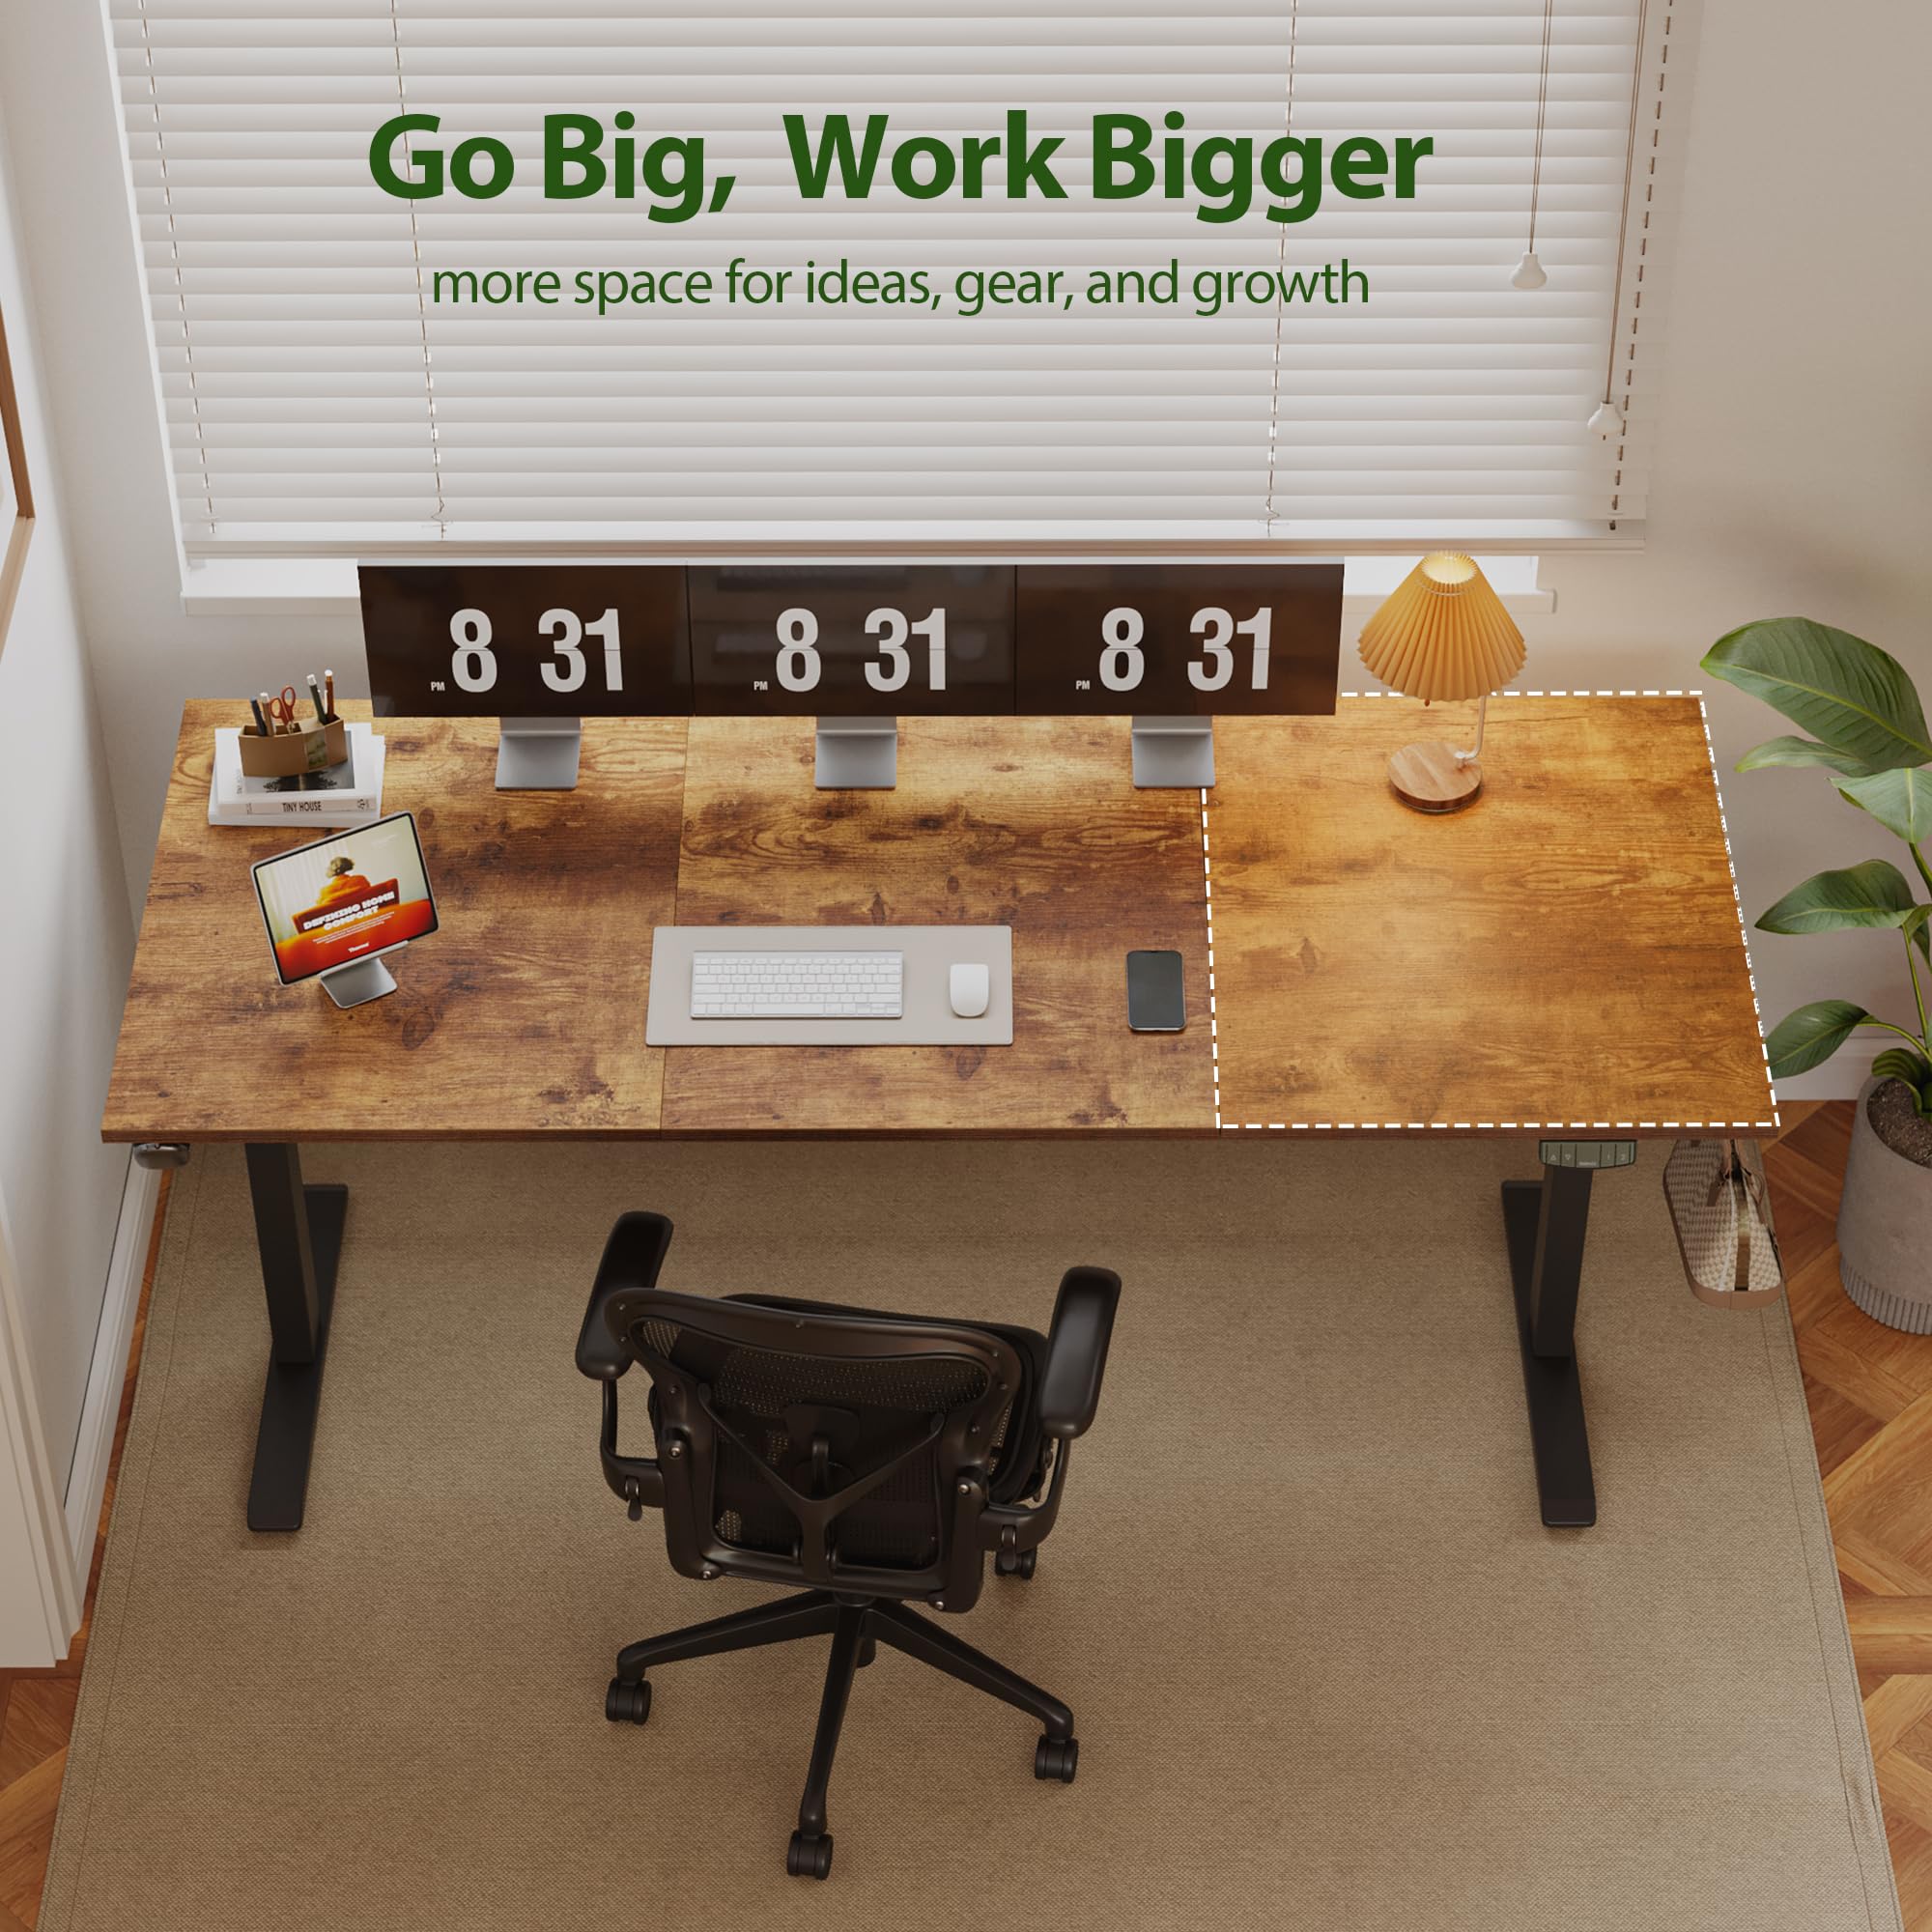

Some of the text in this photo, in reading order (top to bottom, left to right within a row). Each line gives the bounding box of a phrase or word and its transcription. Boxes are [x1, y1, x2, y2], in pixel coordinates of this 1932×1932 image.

[431, 608, 623, 693] PM 8 31
[753, 608, 947, 692] PM 8 31
[1075, 607, 1272, 692] PM 8 31
[282, 801, 323, 812] TINY HOUSE
